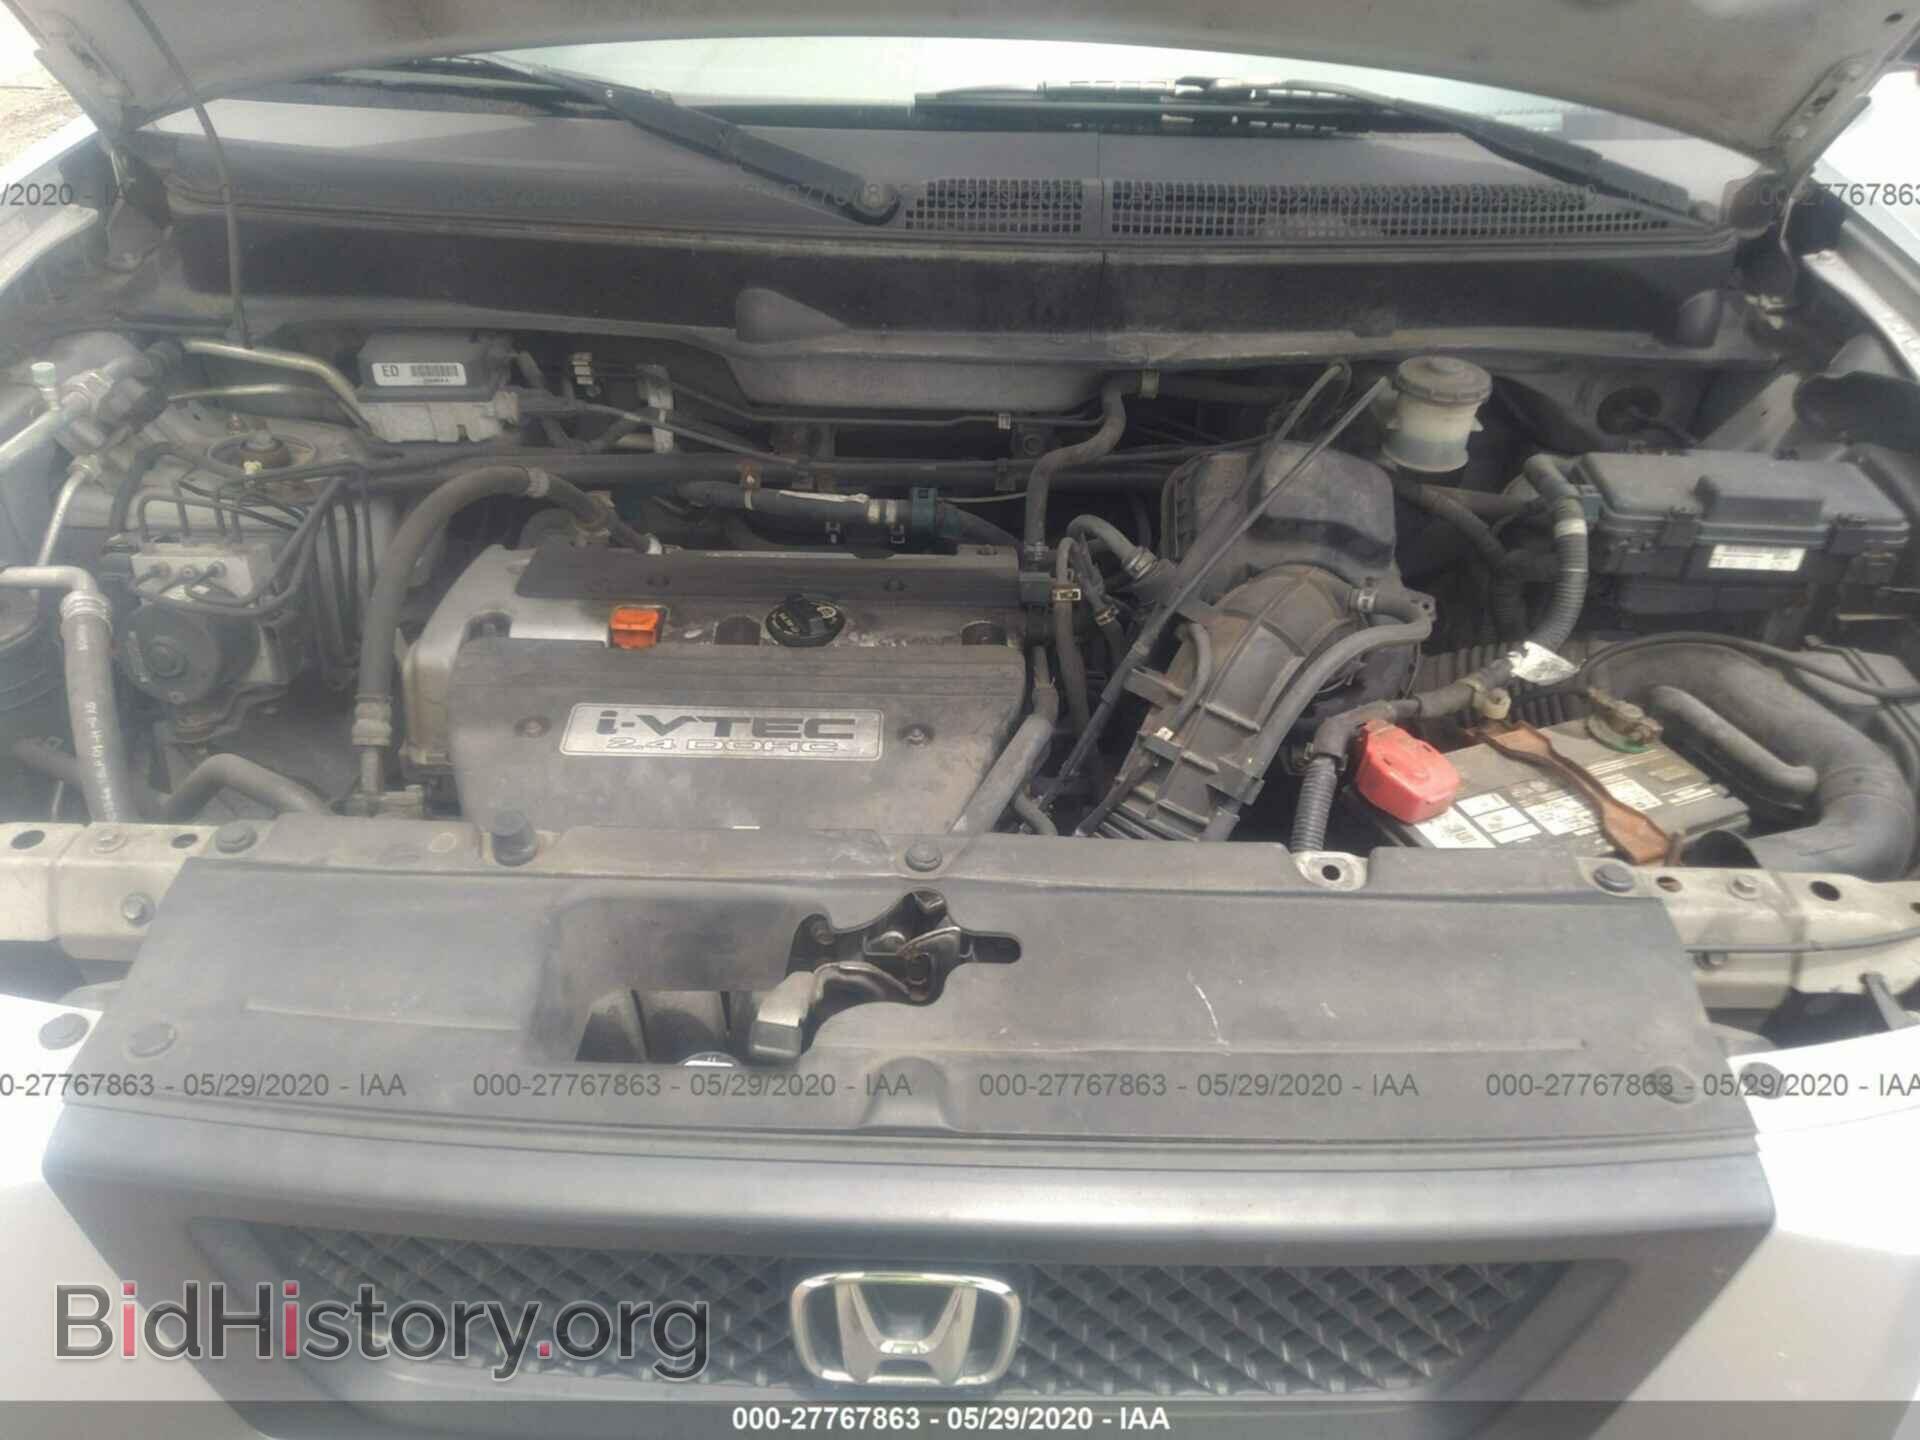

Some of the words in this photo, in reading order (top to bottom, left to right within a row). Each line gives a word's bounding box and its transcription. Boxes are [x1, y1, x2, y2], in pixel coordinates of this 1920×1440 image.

[596, 710, 856, 739] i-VTEC
[607, 737, 677, 750] 2.4
[687, 738, 841, 752] DOHC
